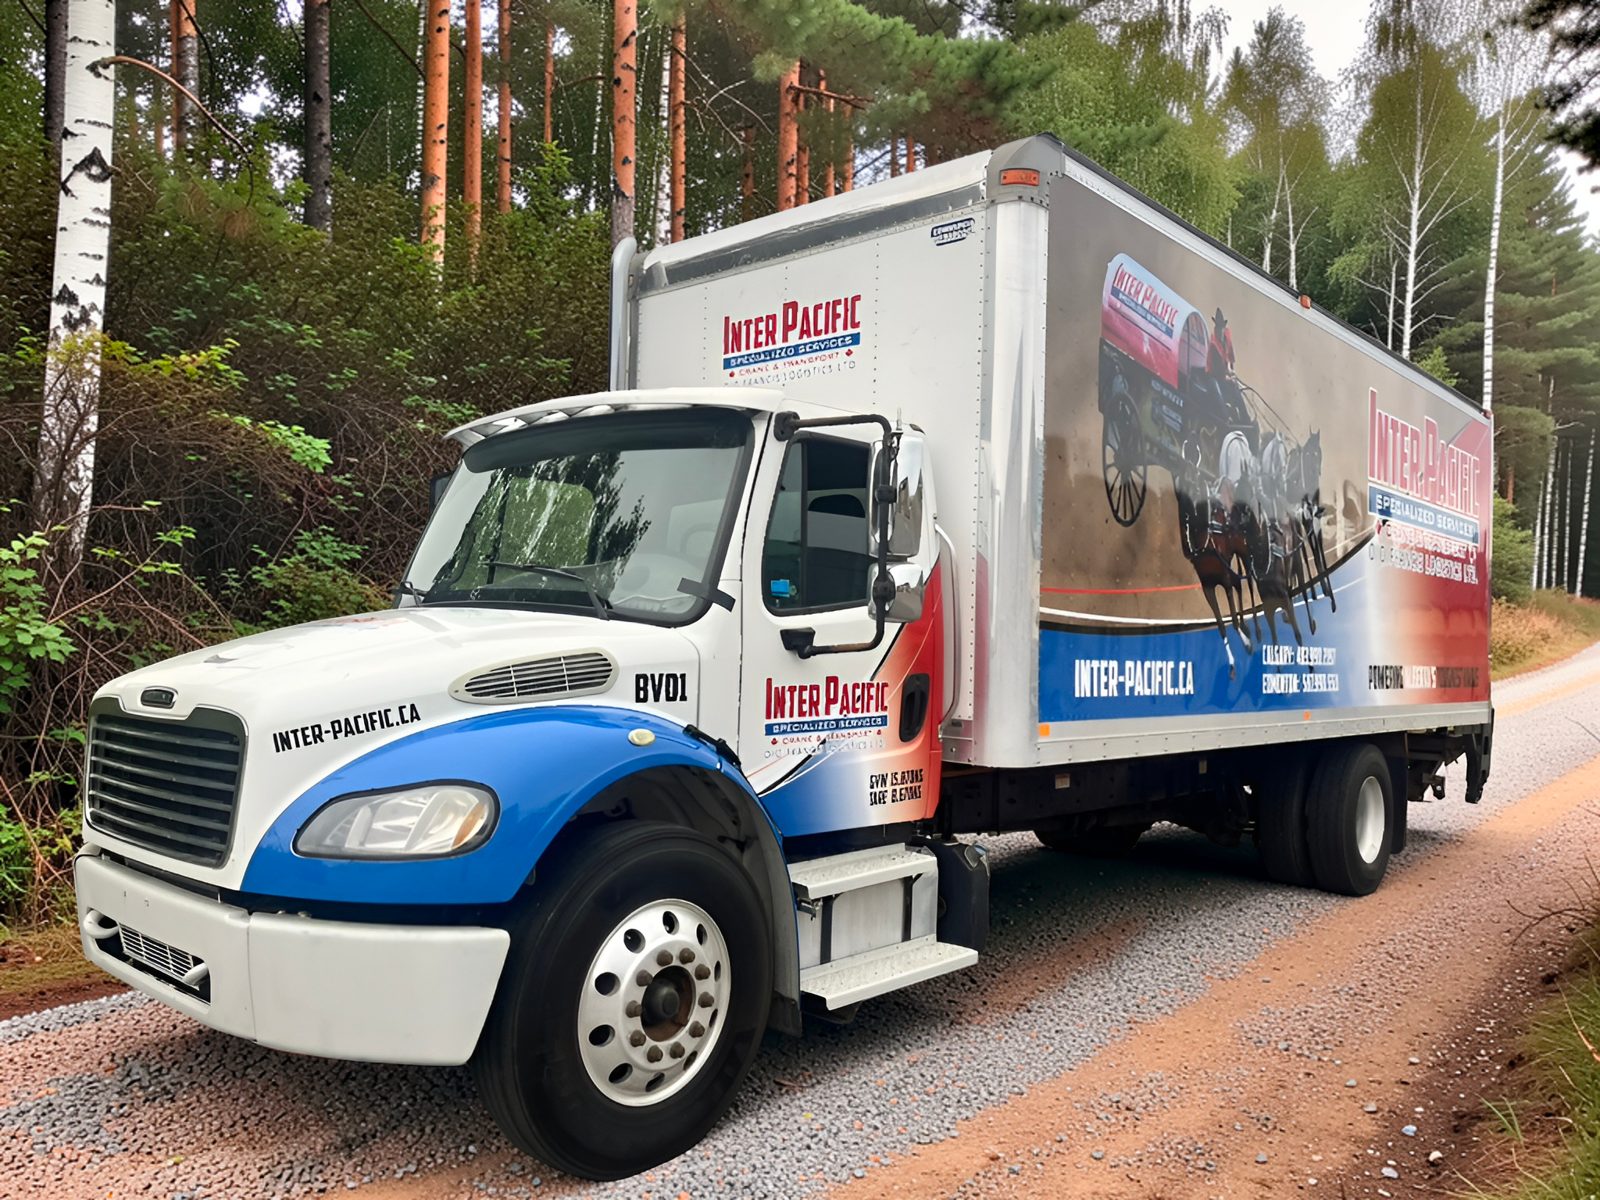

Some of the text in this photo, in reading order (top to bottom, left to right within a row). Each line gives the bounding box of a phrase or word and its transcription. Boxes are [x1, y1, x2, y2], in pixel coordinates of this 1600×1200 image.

[723, 294, 861, 355] INTER PACIFIC
[1368, 387, 1422, 499] INTER
[765, 675, 889, 720] INTER PACIFIC
[1074, 659, 1194, 698] INTER-PACIFIC.CA
[273, 703, 421, 753] INTER-PACIFIC.CA
